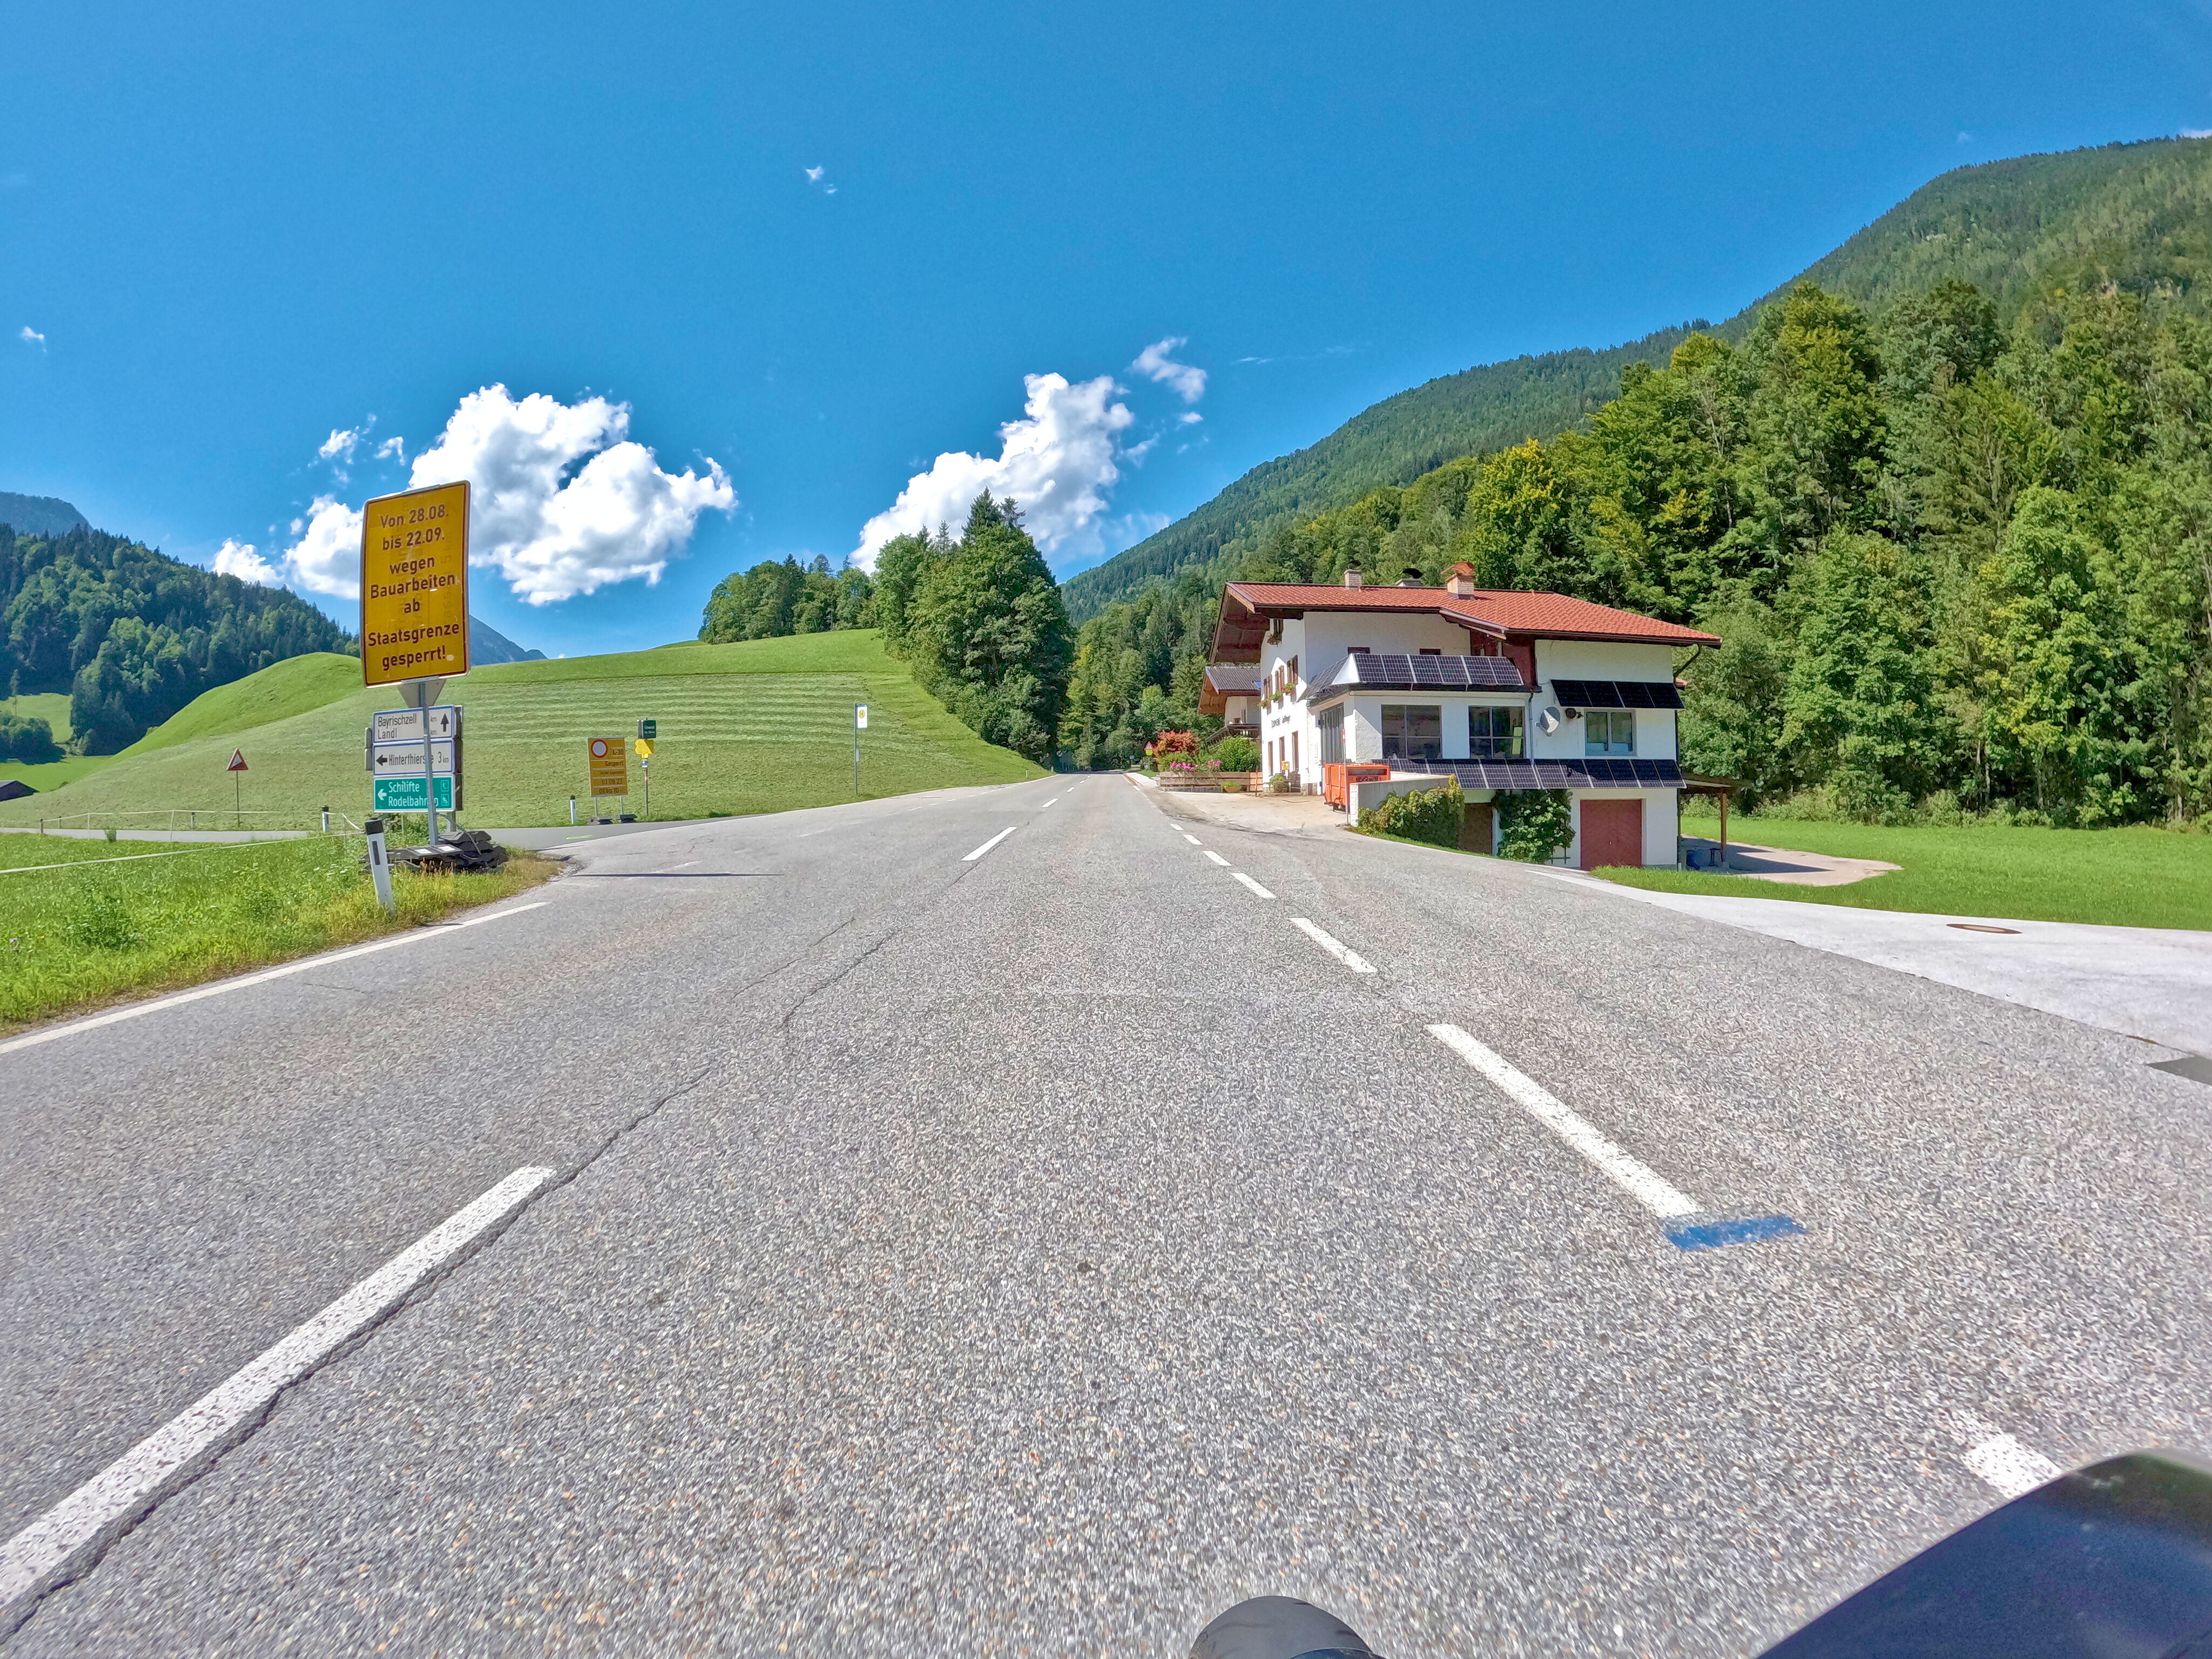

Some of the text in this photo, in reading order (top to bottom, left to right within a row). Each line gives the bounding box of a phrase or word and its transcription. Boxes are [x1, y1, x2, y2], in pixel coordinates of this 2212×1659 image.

[380, 504, 449, 529] Von 28.08.
[382, 527, 445, 550] bis 22.09.
[389, 556, 435, 575] wegen
[370, 573, 455, 599] Bauarbeiten
[403, 597, 420, 614] ab
[368, 622, 460, 647] Staatsgrenze
[382, 644, 446, 671] gesperrt!
[378, 713, 417, 729] Bayrischzell
[378, 727, 397, 739] Landl
[389, 753, 434, 766] Hinterthierse
[437, 751, 442, 764] 3
[388, 781, 420, 793] Schilifte
[388, 795, 439, 807] Rodelbahnn
